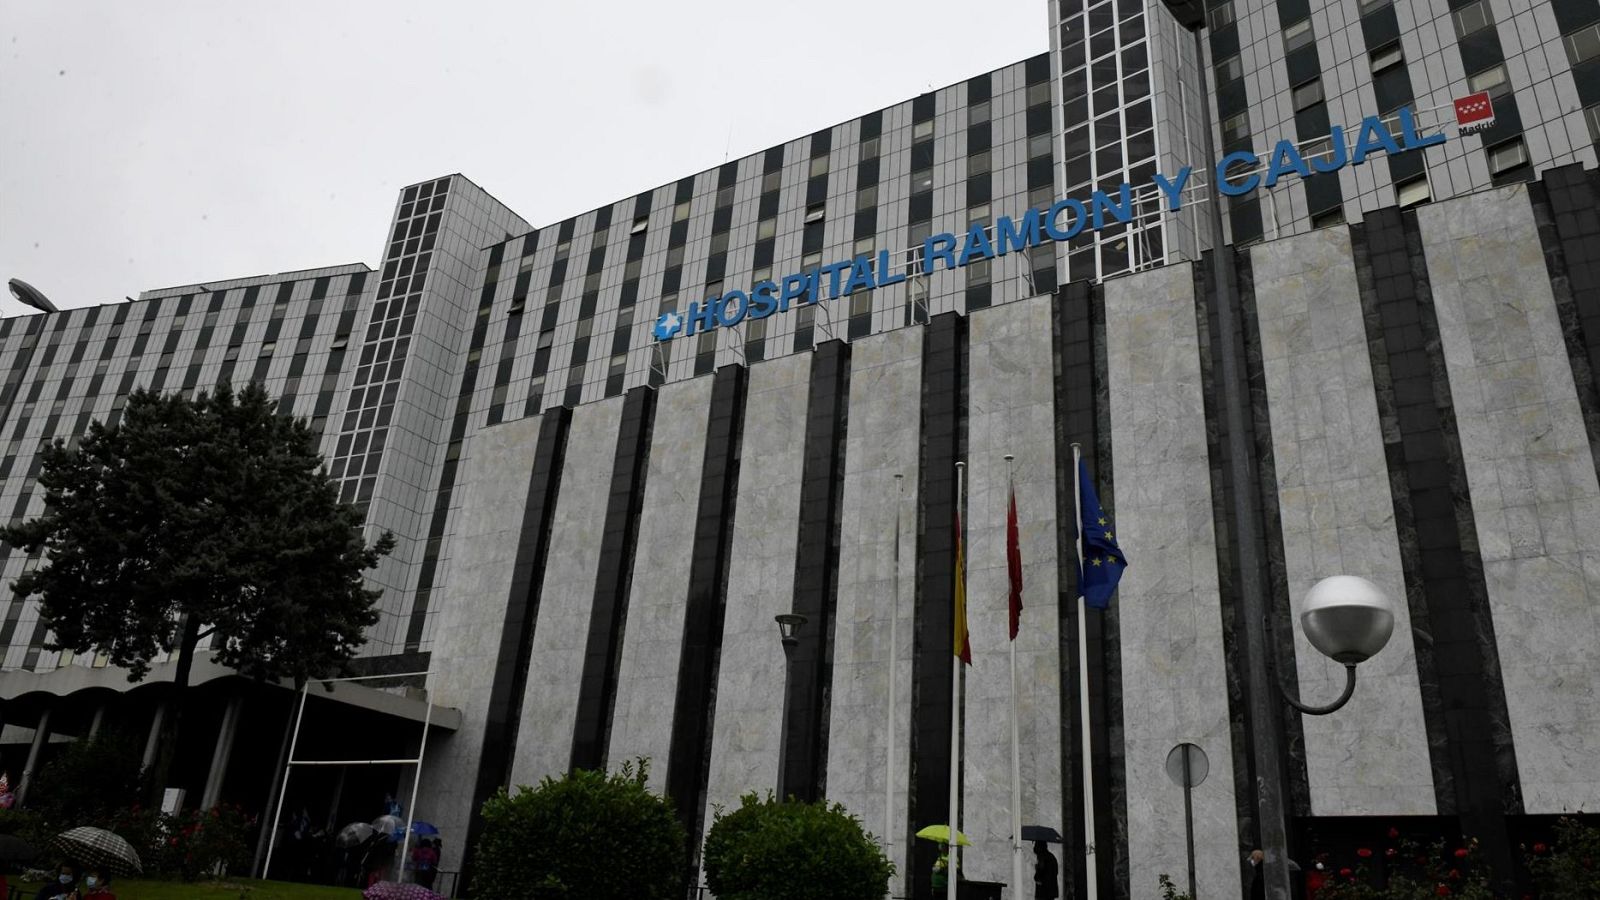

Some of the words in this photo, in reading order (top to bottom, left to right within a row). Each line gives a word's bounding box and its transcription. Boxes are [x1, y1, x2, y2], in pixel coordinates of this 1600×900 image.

[1458, 119, 1496, 137] Madrid
[686, 250, 907, 336] HOSPITAL
[922, 183, 1133, 276] RAMON
[1152, 166, 1192, 212] Y
[1215, 107, 1446, 196] CAJAL
